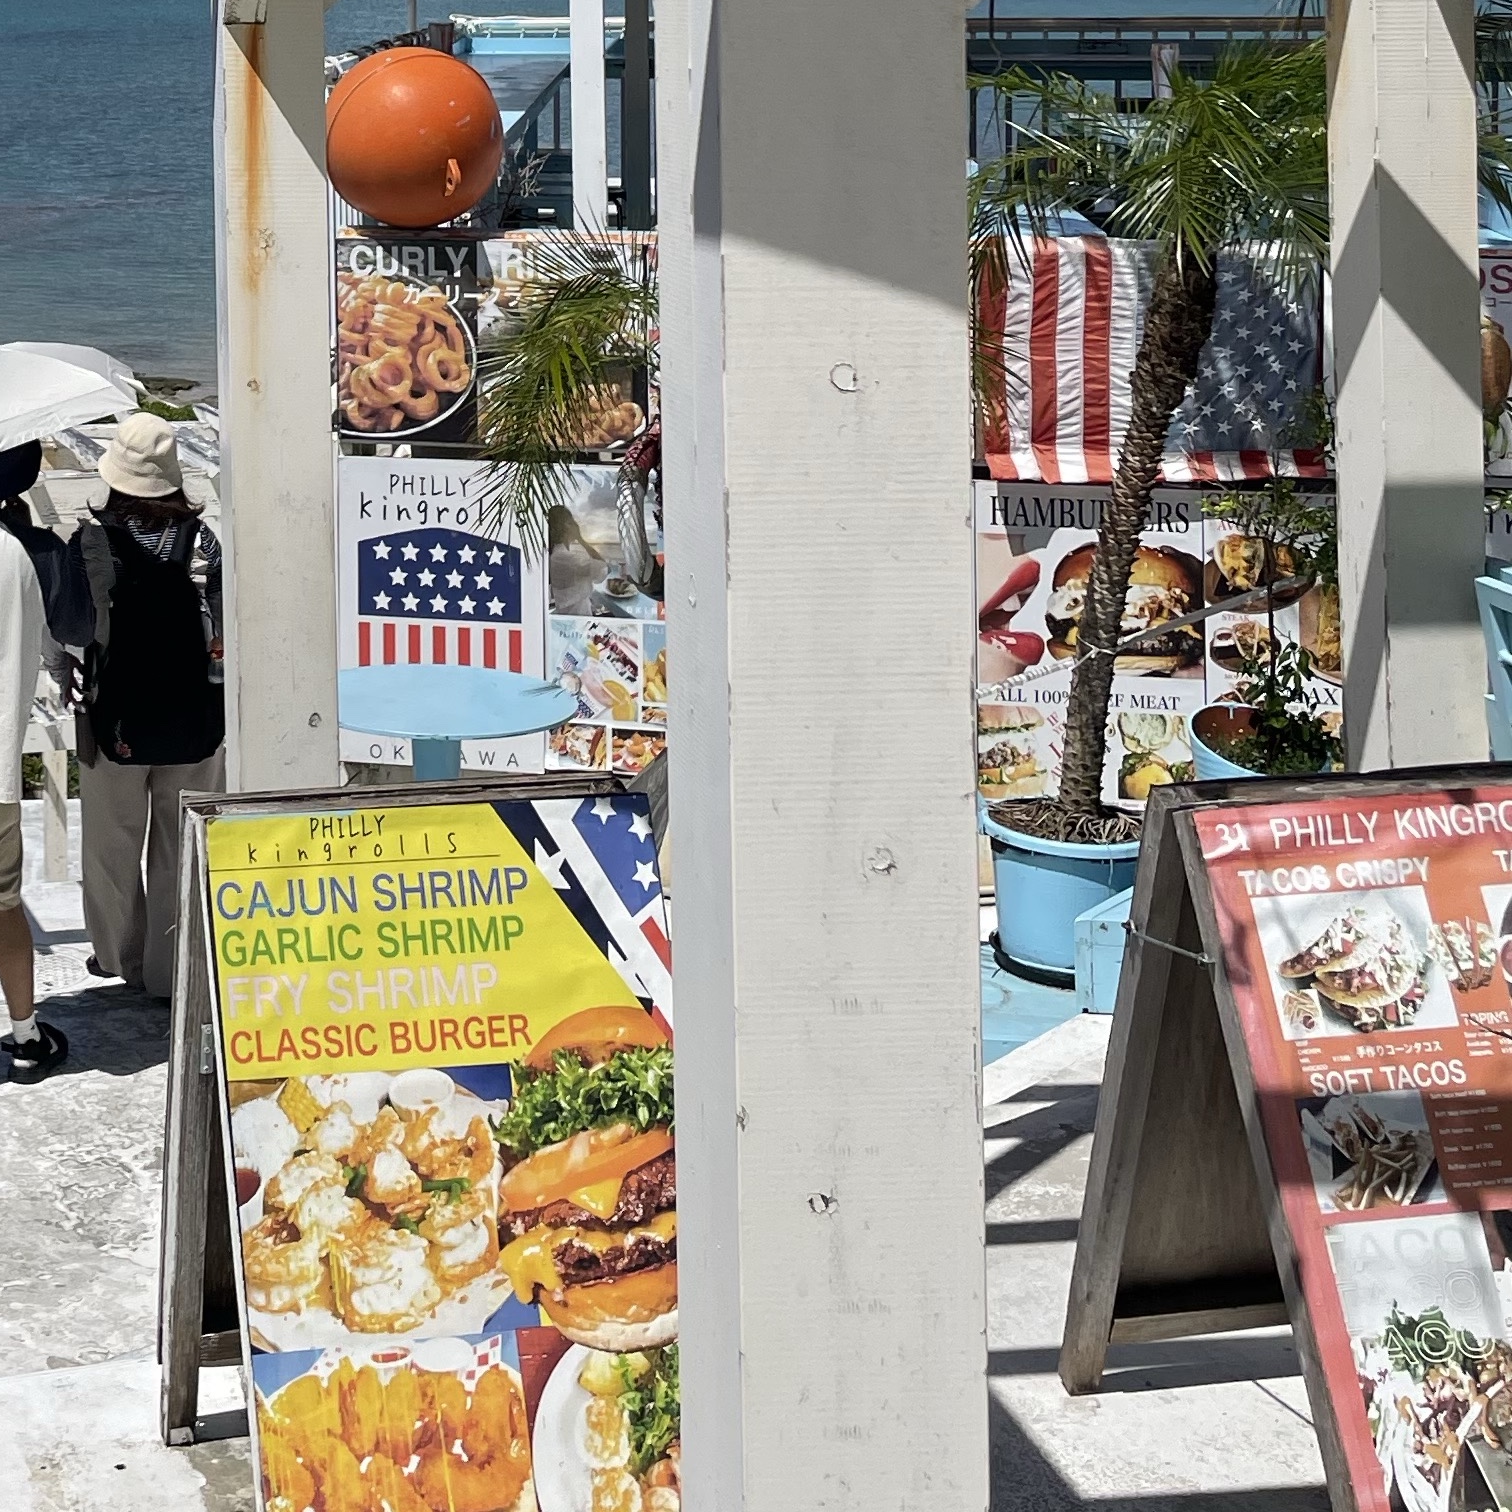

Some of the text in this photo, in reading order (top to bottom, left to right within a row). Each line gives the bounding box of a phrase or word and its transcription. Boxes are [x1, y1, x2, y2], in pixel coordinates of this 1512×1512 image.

[349, 244, 469, 279] CURLY
[389, 473, 472, 498] PHILLY
[994, 689, 1028, 704] ALL
[1129, 694, 1181, 711] MEAT
[309, 813, 386, 840] PHILLY
[1268, 810, 1379, 850] PHILLY
[217, 866, 529, 922] CAJUN SHRIMP
[1237, 856, 1430, 897] TACOS CRISPY
[221, 915, 525, 968] GARLIC SHRIMP
[226, 961, 500, 1020] FRY SHRIMP
[230, 1013, 533, 1065] CLASSIC BURGER
[1309, 1058, 1467, 1098] SOFT TACOS
